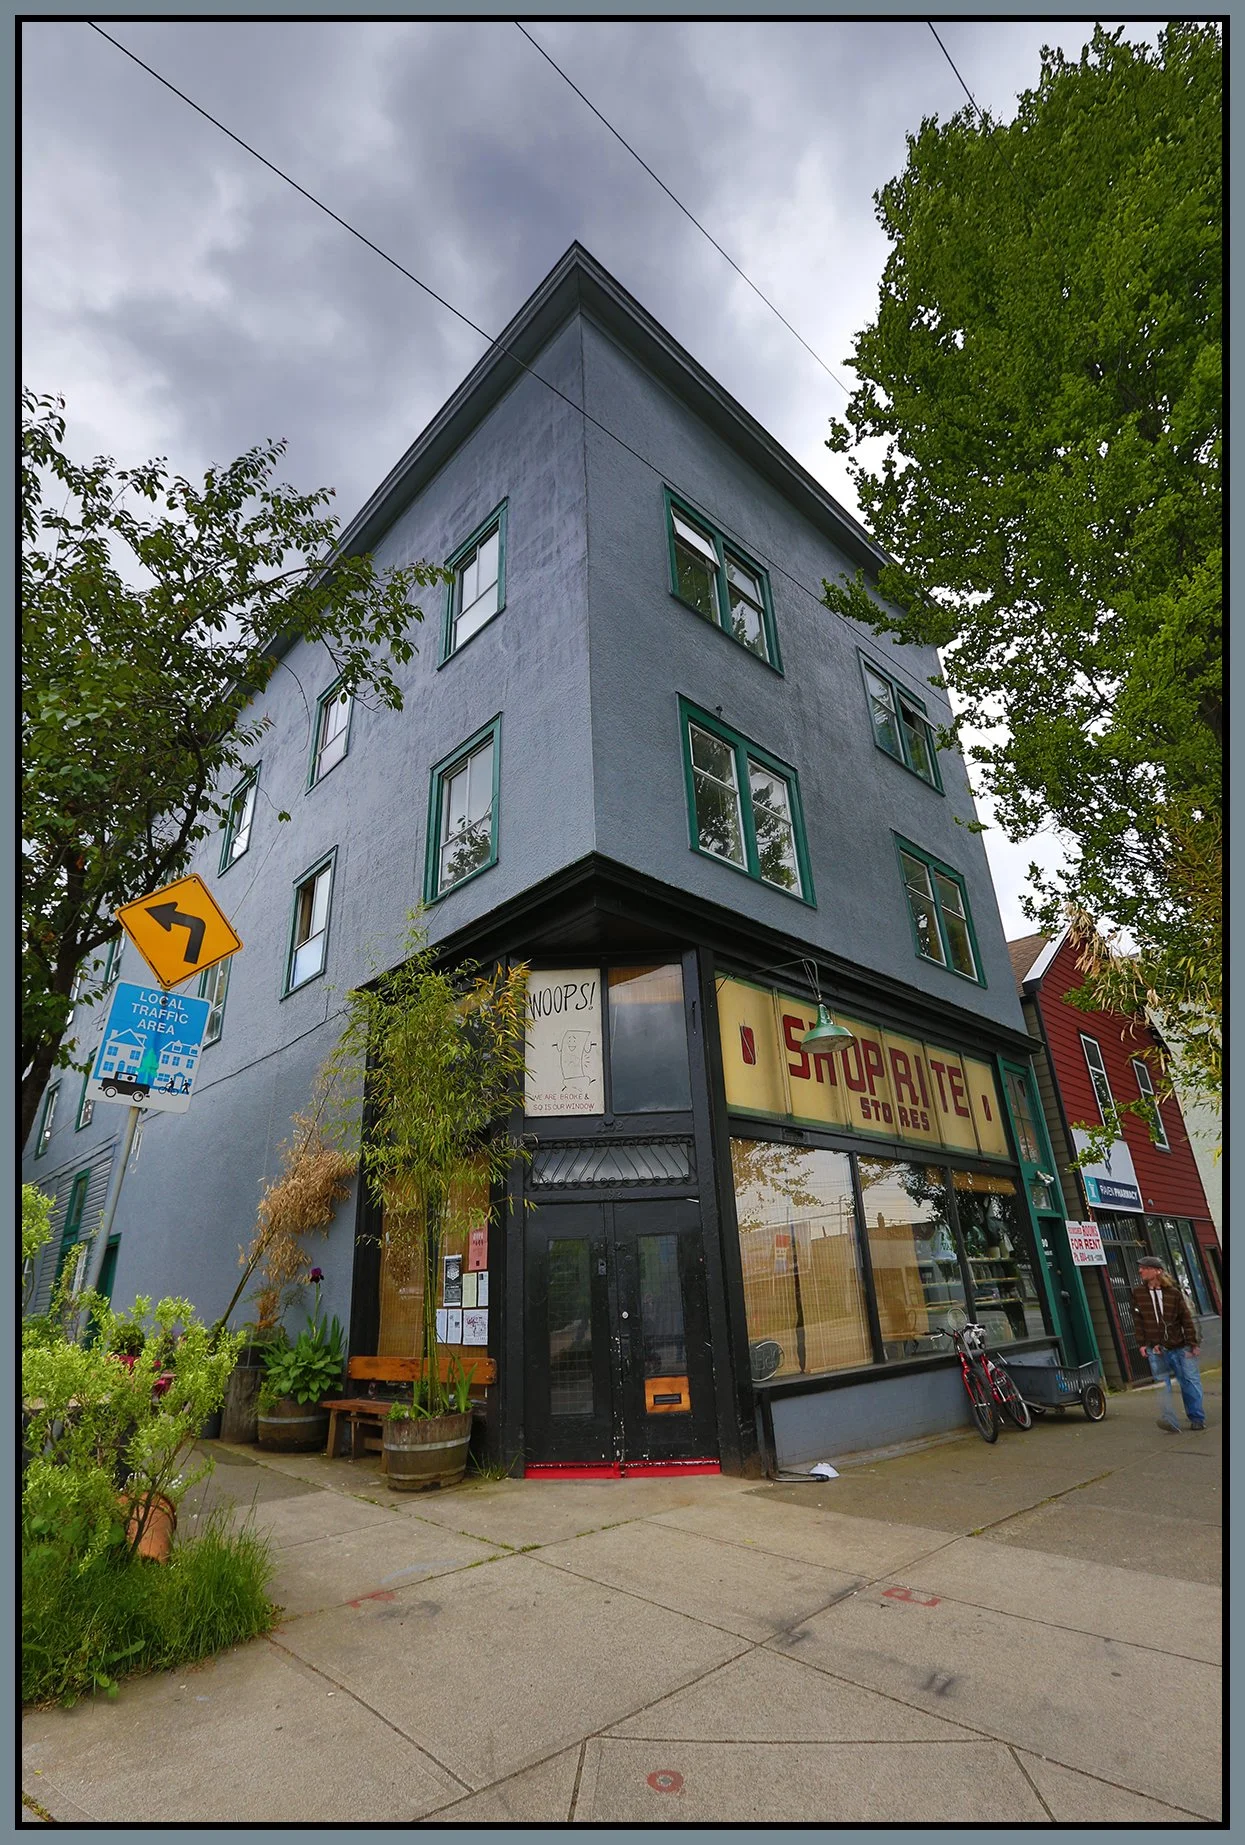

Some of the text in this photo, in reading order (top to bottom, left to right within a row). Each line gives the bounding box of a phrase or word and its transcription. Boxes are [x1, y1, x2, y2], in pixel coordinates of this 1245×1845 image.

[140, 991, 185, 1011] LOCAL
[528, 981, 596, 1020] WOOPS!
[132, 1003, 189, 1024] TRAFFIC
[137, 1019, 175, 1036] AREA
[859, 1096, 930, 1131] STORES
[1113, 1187, 1138, 1200] PHARMACY
[1081, 1225, 1099, 1237] ROOMS
[1070, 1238, 1101, 1250] FOR RENT
